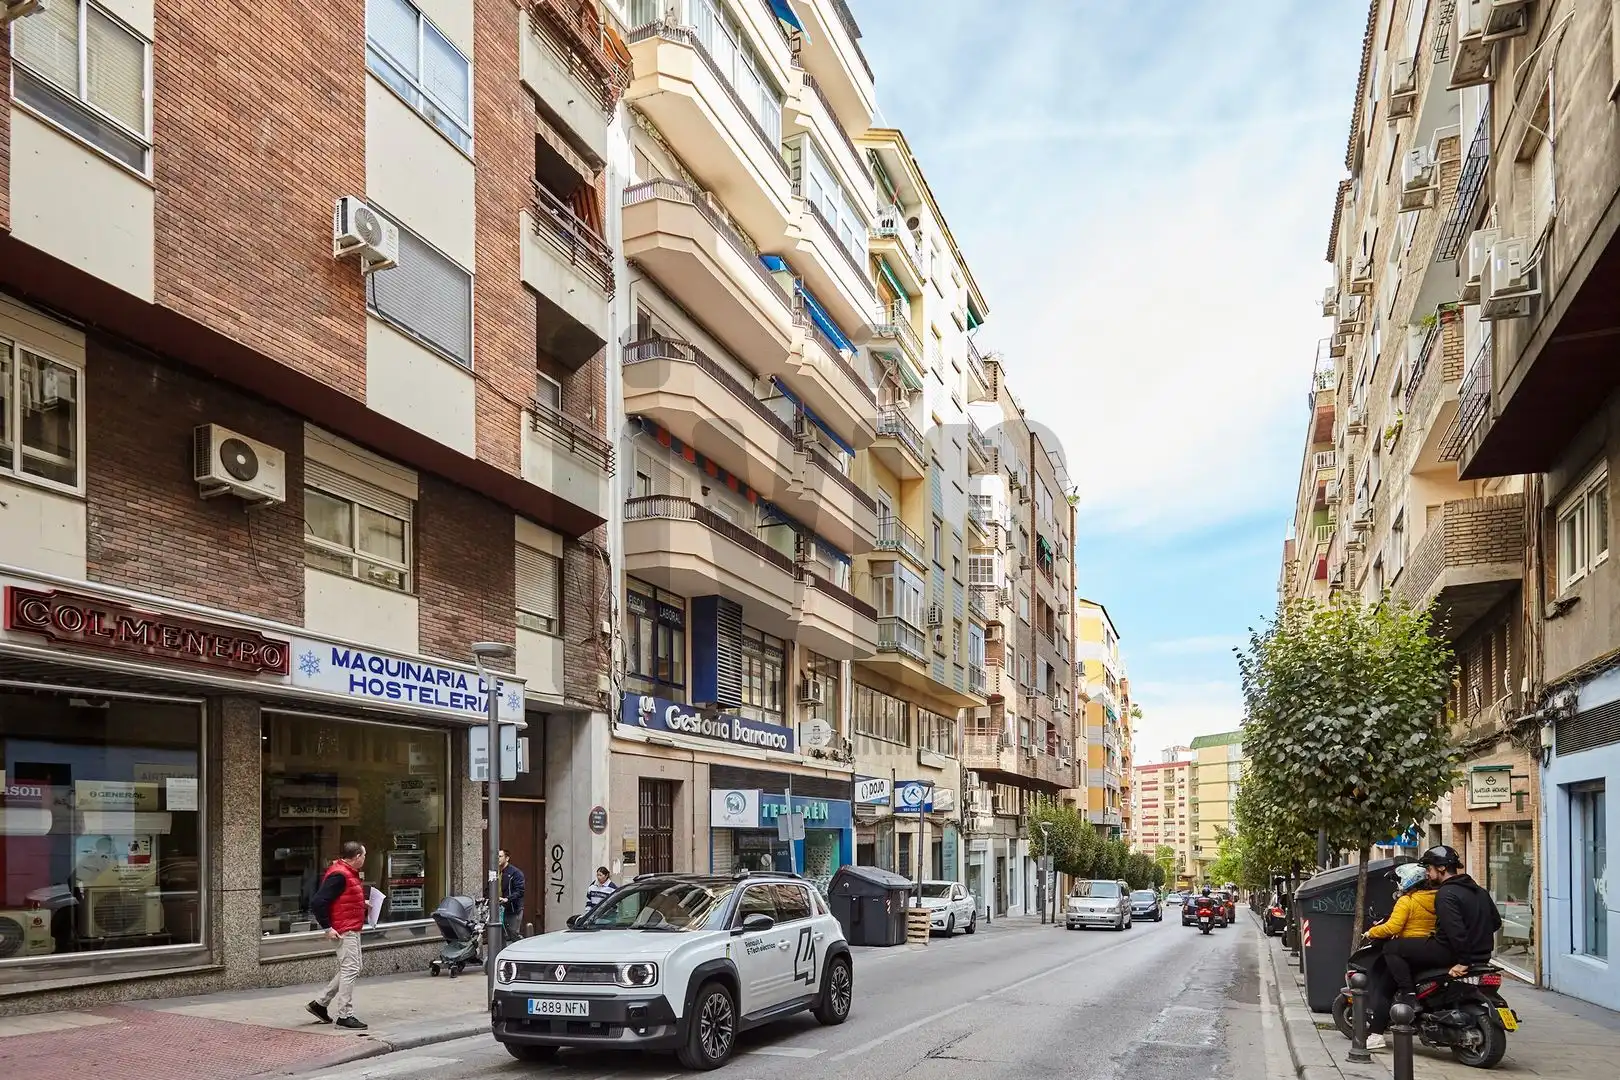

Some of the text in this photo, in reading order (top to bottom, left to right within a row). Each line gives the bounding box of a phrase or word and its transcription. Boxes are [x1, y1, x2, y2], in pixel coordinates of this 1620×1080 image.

[17, 596, 284, 669] COLMENERO
[331, 647, 468, 691] MAQUINARIA
[665, 705, 730, 740] Gestoría
[732, 718, 787, 750] Barranco
[869, 780, 885, 796] DOJO
[535, 1001, 587, 1014] 4889 NFN
